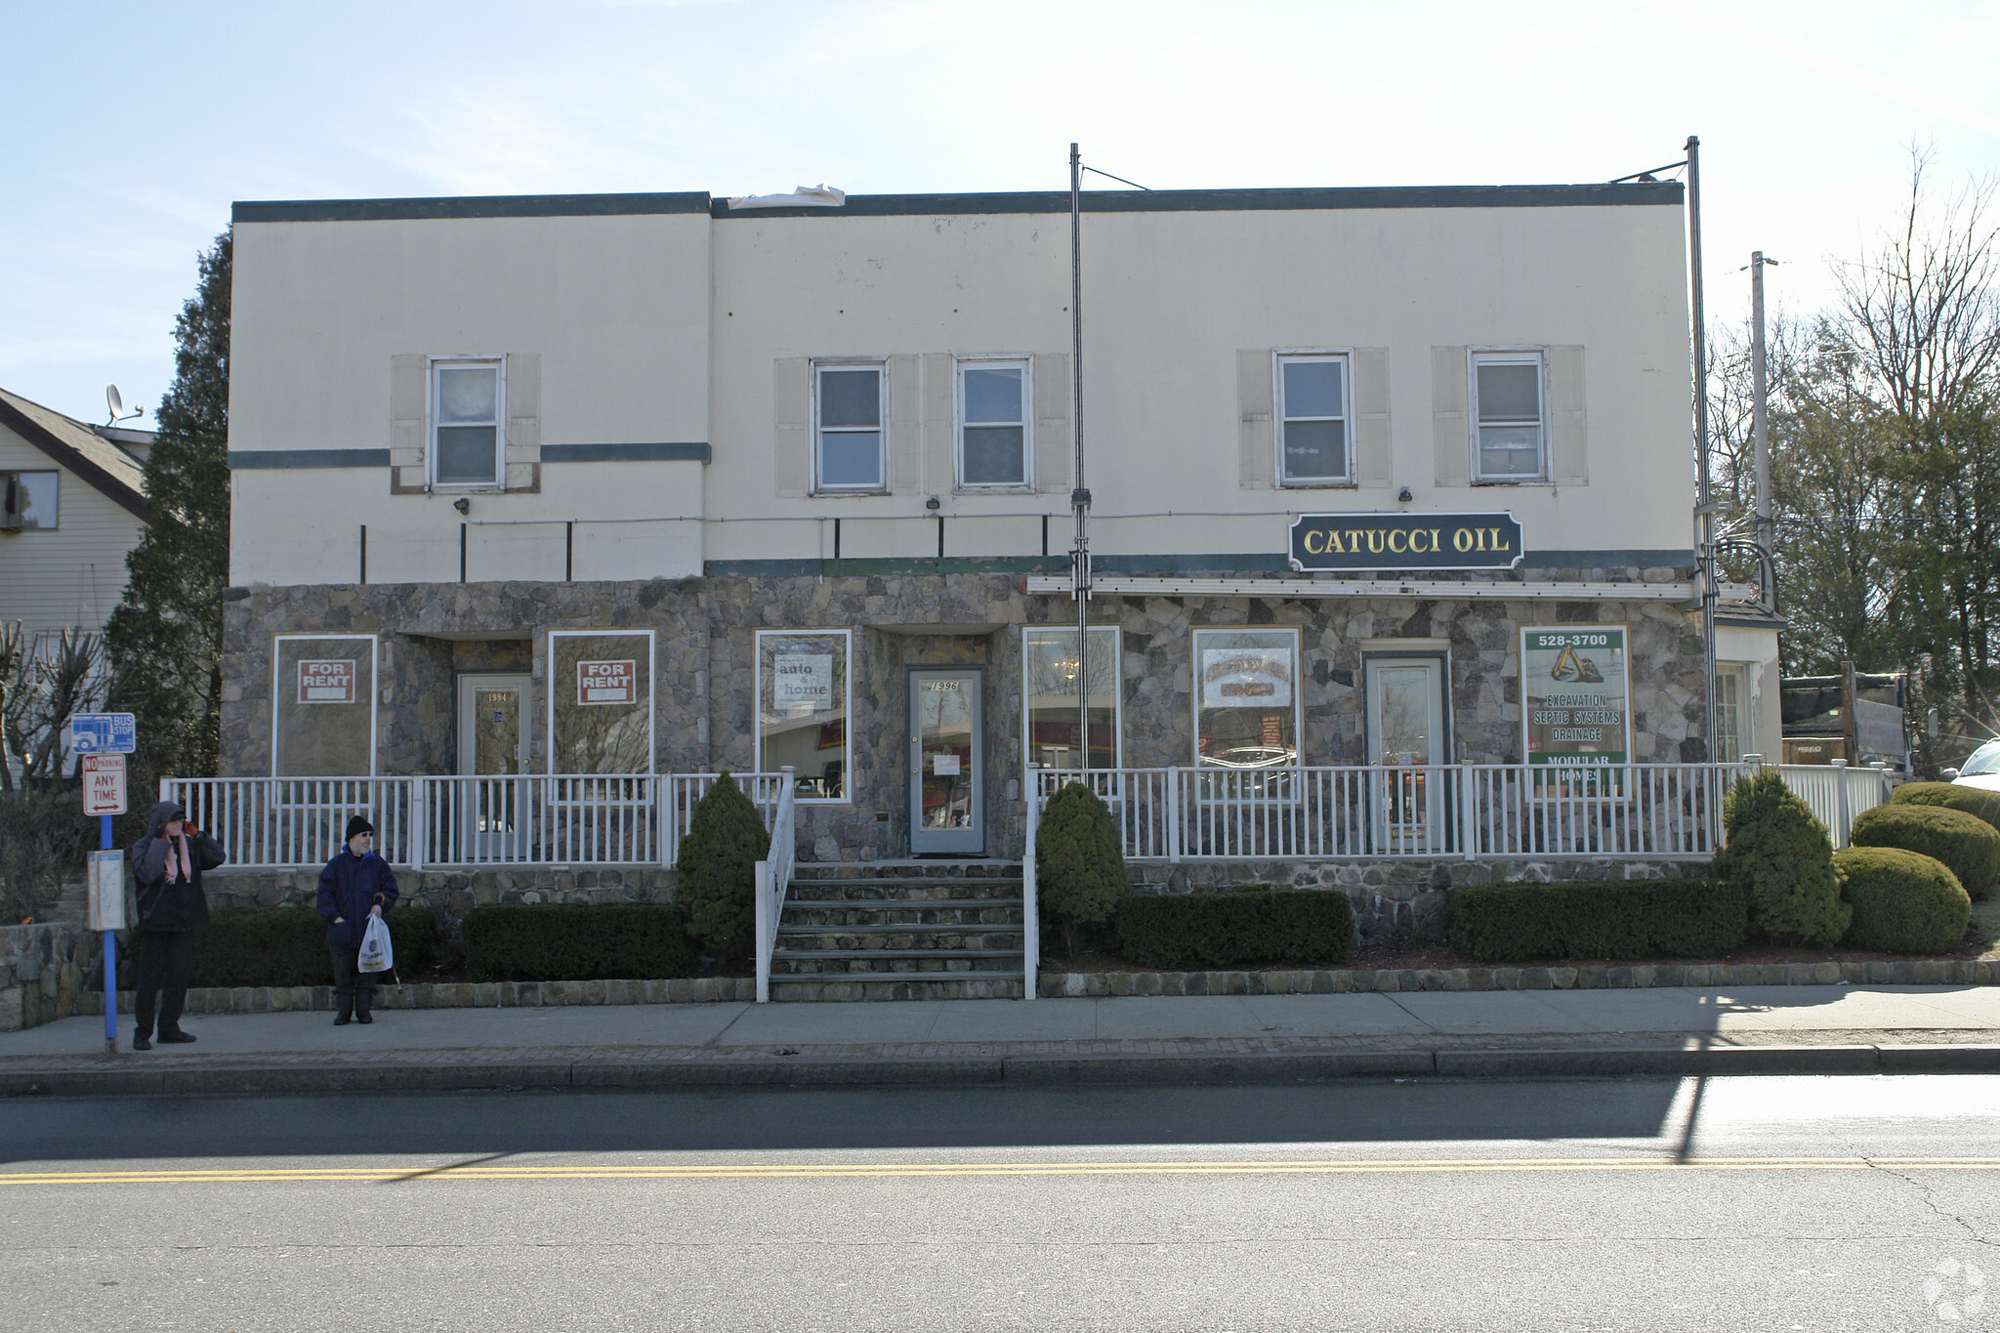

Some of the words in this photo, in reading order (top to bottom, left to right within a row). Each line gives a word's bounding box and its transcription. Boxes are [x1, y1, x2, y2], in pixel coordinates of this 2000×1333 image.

[1303, 528, 1442, 555] CATUCCI
[1453, 527, 1510, 553] OIL
[1538, 634, 1608, 646] 528-3700
[308, 664, 345, 676] FOR
[588, 664, 625, 676] FOR
[779, 663, 813, 675] auto
[303, 675, 350, 688] RENT
[583, 676, 631, 688] RENT
[932, 682, 958, 691] 1996
[783, 683, 827, 695] home
[488, 693, 507, 702] 1994
[1546, 694, 1606, 708] EXCAVATION
[113, 716, 133, 726] BUS
[1534, 711, 1570, 724] SEPTIC
[1574, 711, 1620, 724] SYSTEMS
[113, 726, 133, 735] STOP
[1553, 728, 1602, 741] DRAINAGE
[85, 758, 97, 771] NO
[97, 758, 123, 768] PARKING
[1548, 756, 1610, 765] MODULAR
[94, 775, 116, 787] ANY
[94, 790, 117, 801] TIME
